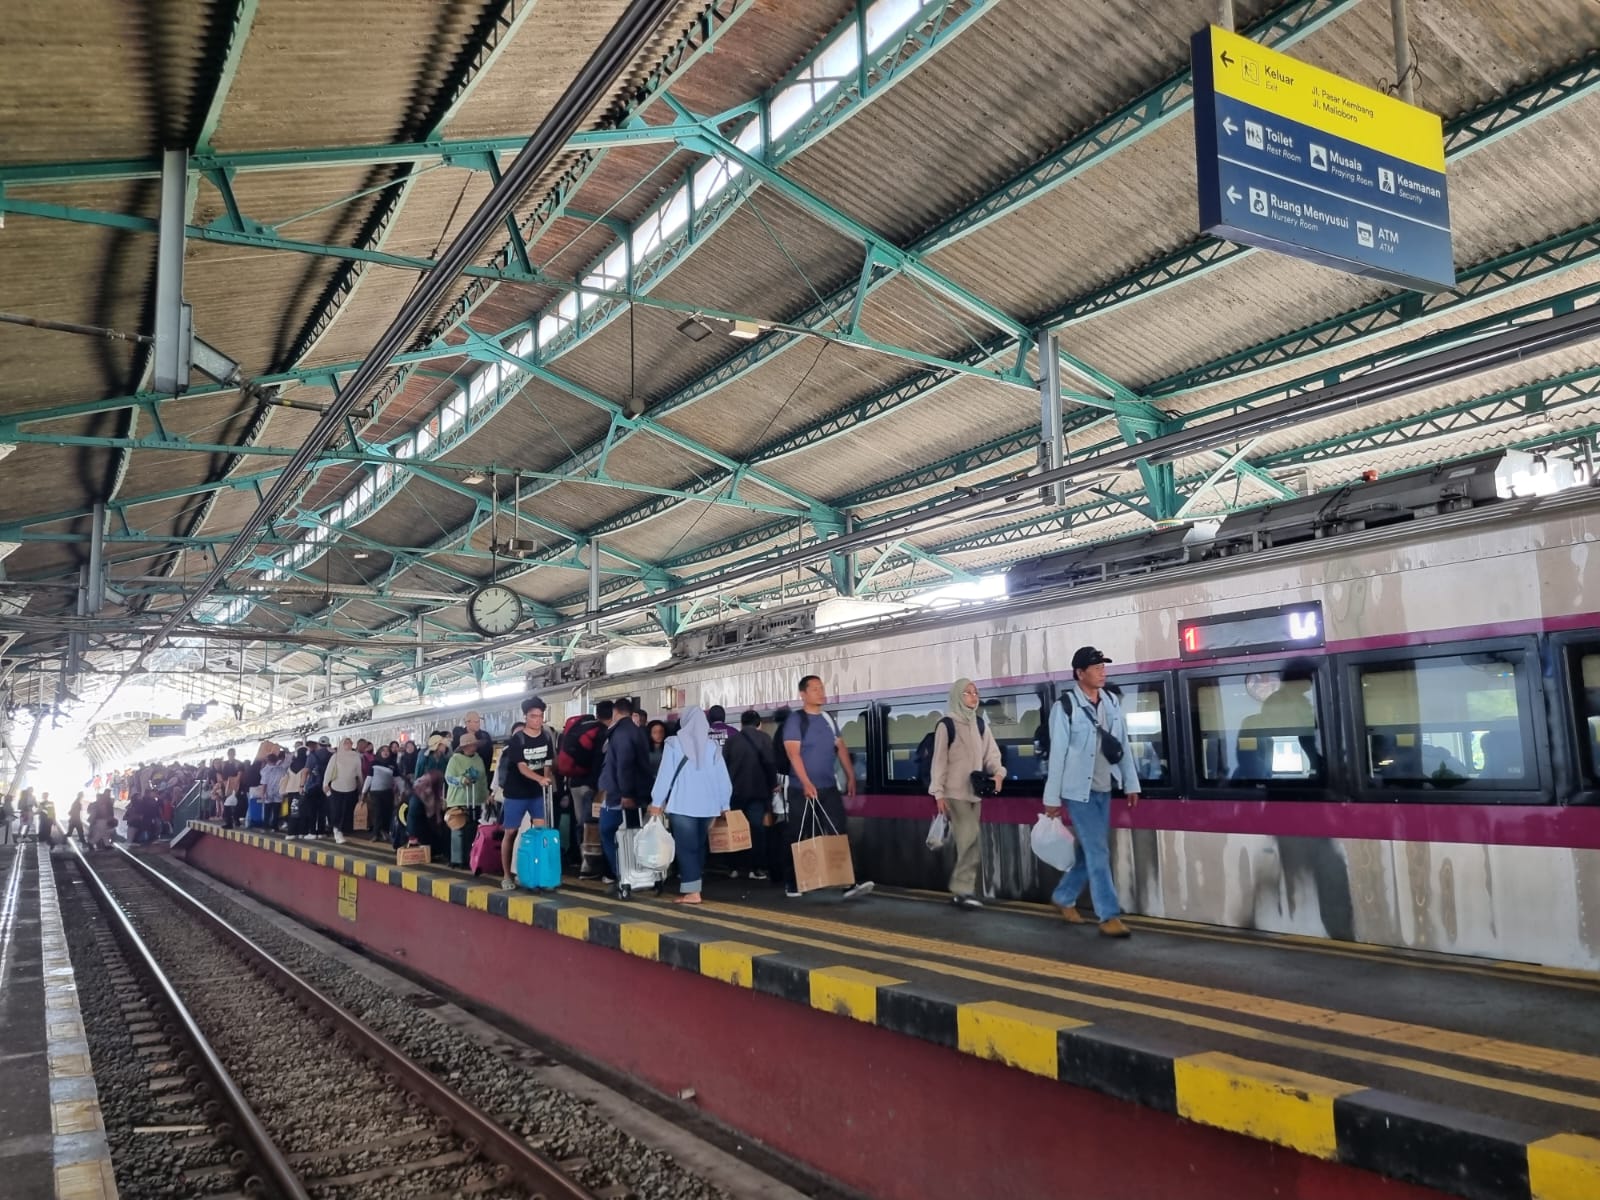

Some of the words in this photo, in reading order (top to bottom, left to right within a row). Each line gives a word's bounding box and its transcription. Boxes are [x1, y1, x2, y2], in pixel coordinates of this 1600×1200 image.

[1264, 65, 1294, 86] Keluar
[1266, 80, 1278, 92] Exit
[1311, 87, 1320, 96] Jl.
[1322, 89, 1340, 104] Pasar
[1342, 97, 1374, 118] Kembang
[1312, 100, 1321, 109] Jl.
[1323, 102, 1358, 123] Malioboro
[1265, 127, 1293, 148] Toilet
[1267, 144, 1281, 156] Rest
[1283, 149, 1301, 163] Room
[1330, 149, 1362, 171] Musala
[1332, 166, 1355, 183] Praying
[1357, 174, 1373, 187] Room
[1397, 174, 1441, 198] Keamanan
[1399, 189, 1422, 205] Security
[1270, 193, 1301, 217] Ruang
[1303, 204, 1349, 229] Menyusui
[1271, 210, 1298, 227] Nursery
[1299, 218, 1318, 231] Room
[1378, 227, 1399, 244] ATM
[1379, 243, 1394, 254] ATM
[1185, 627, 1197, 651] 1
